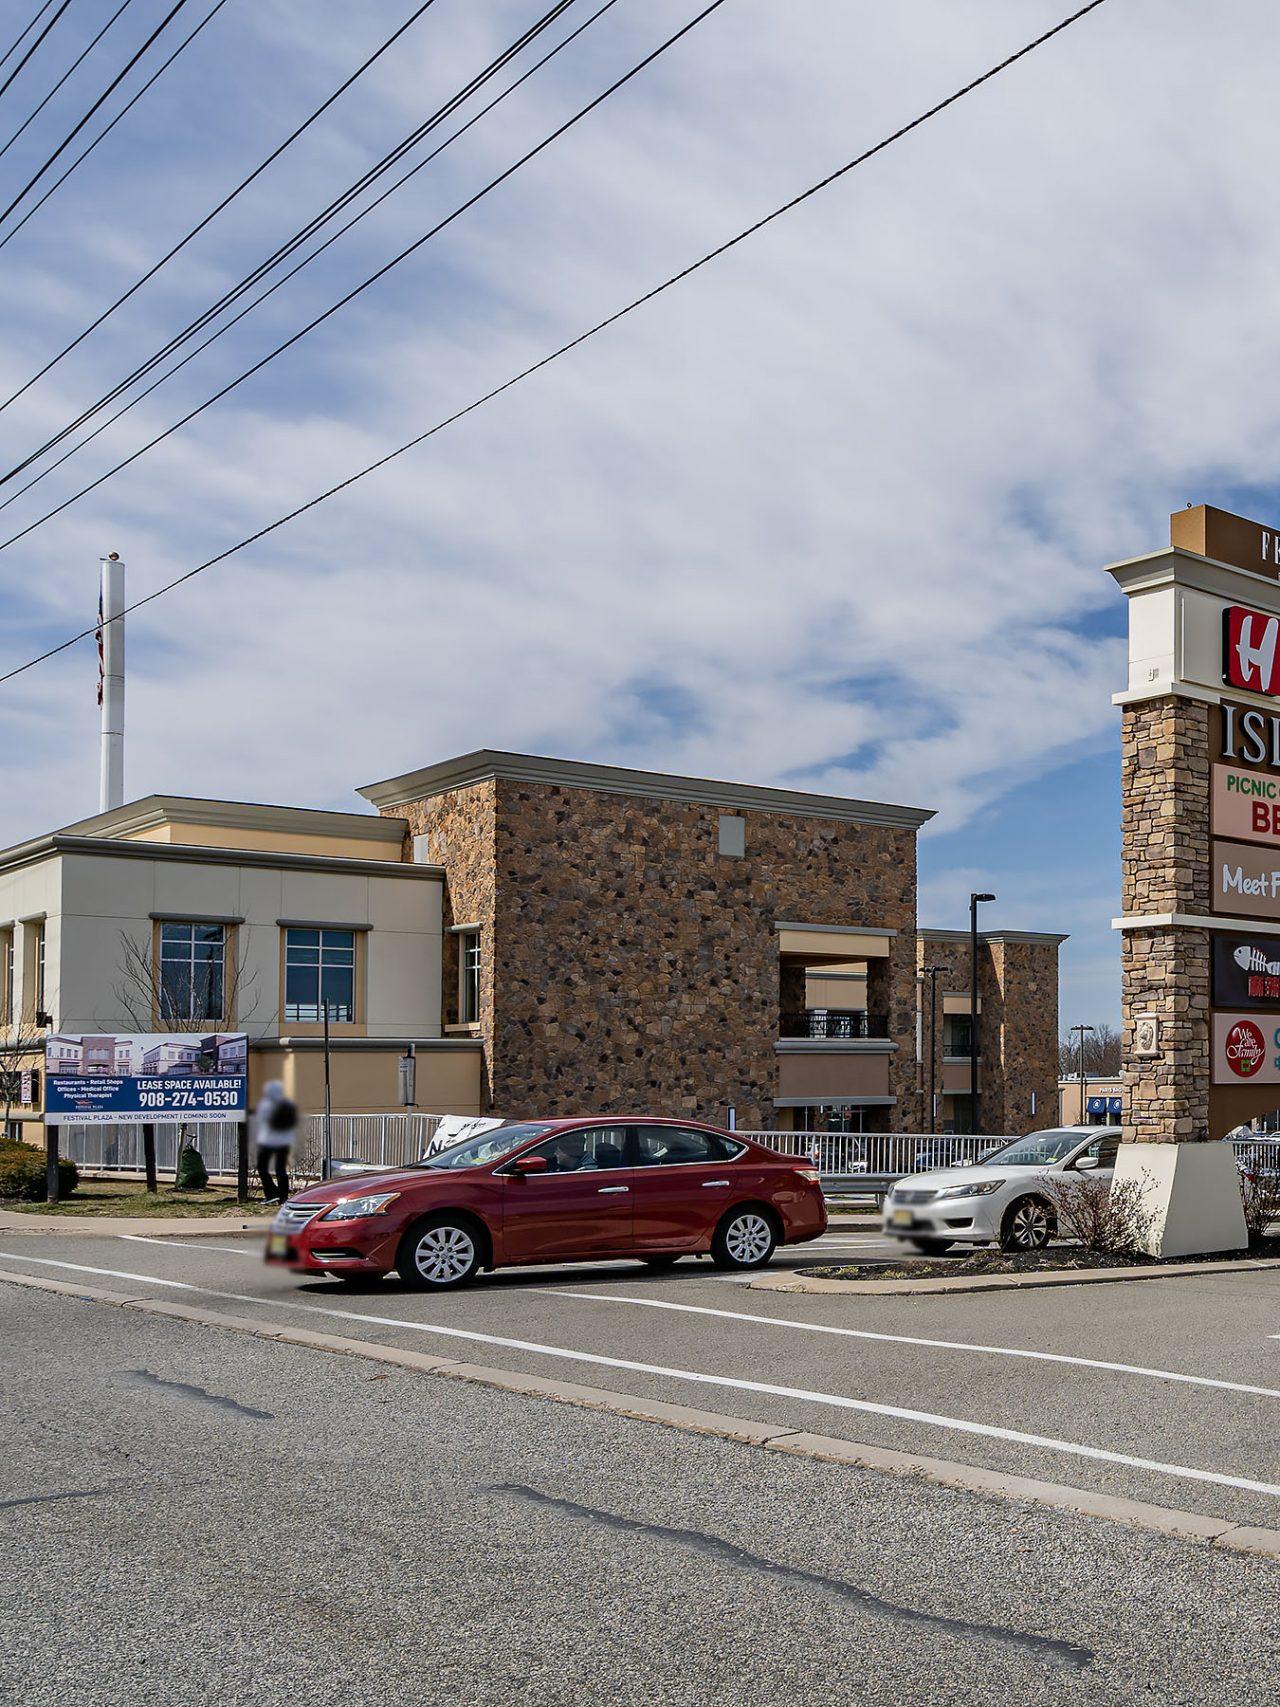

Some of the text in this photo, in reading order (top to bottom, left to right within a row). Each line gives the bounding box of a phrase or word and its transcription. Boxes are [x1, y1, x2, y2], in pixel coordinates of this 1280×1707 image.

[1236, 615, 1279, 692] H
[1227, 774, 1276, 798] PICNIC
[1222, 864, 1269, 896] Meet
[137, 1079, 242, 1090] LEASE SPACE AVAILABLE!
[139, 1091, 238, 1107] 908-274-0530
